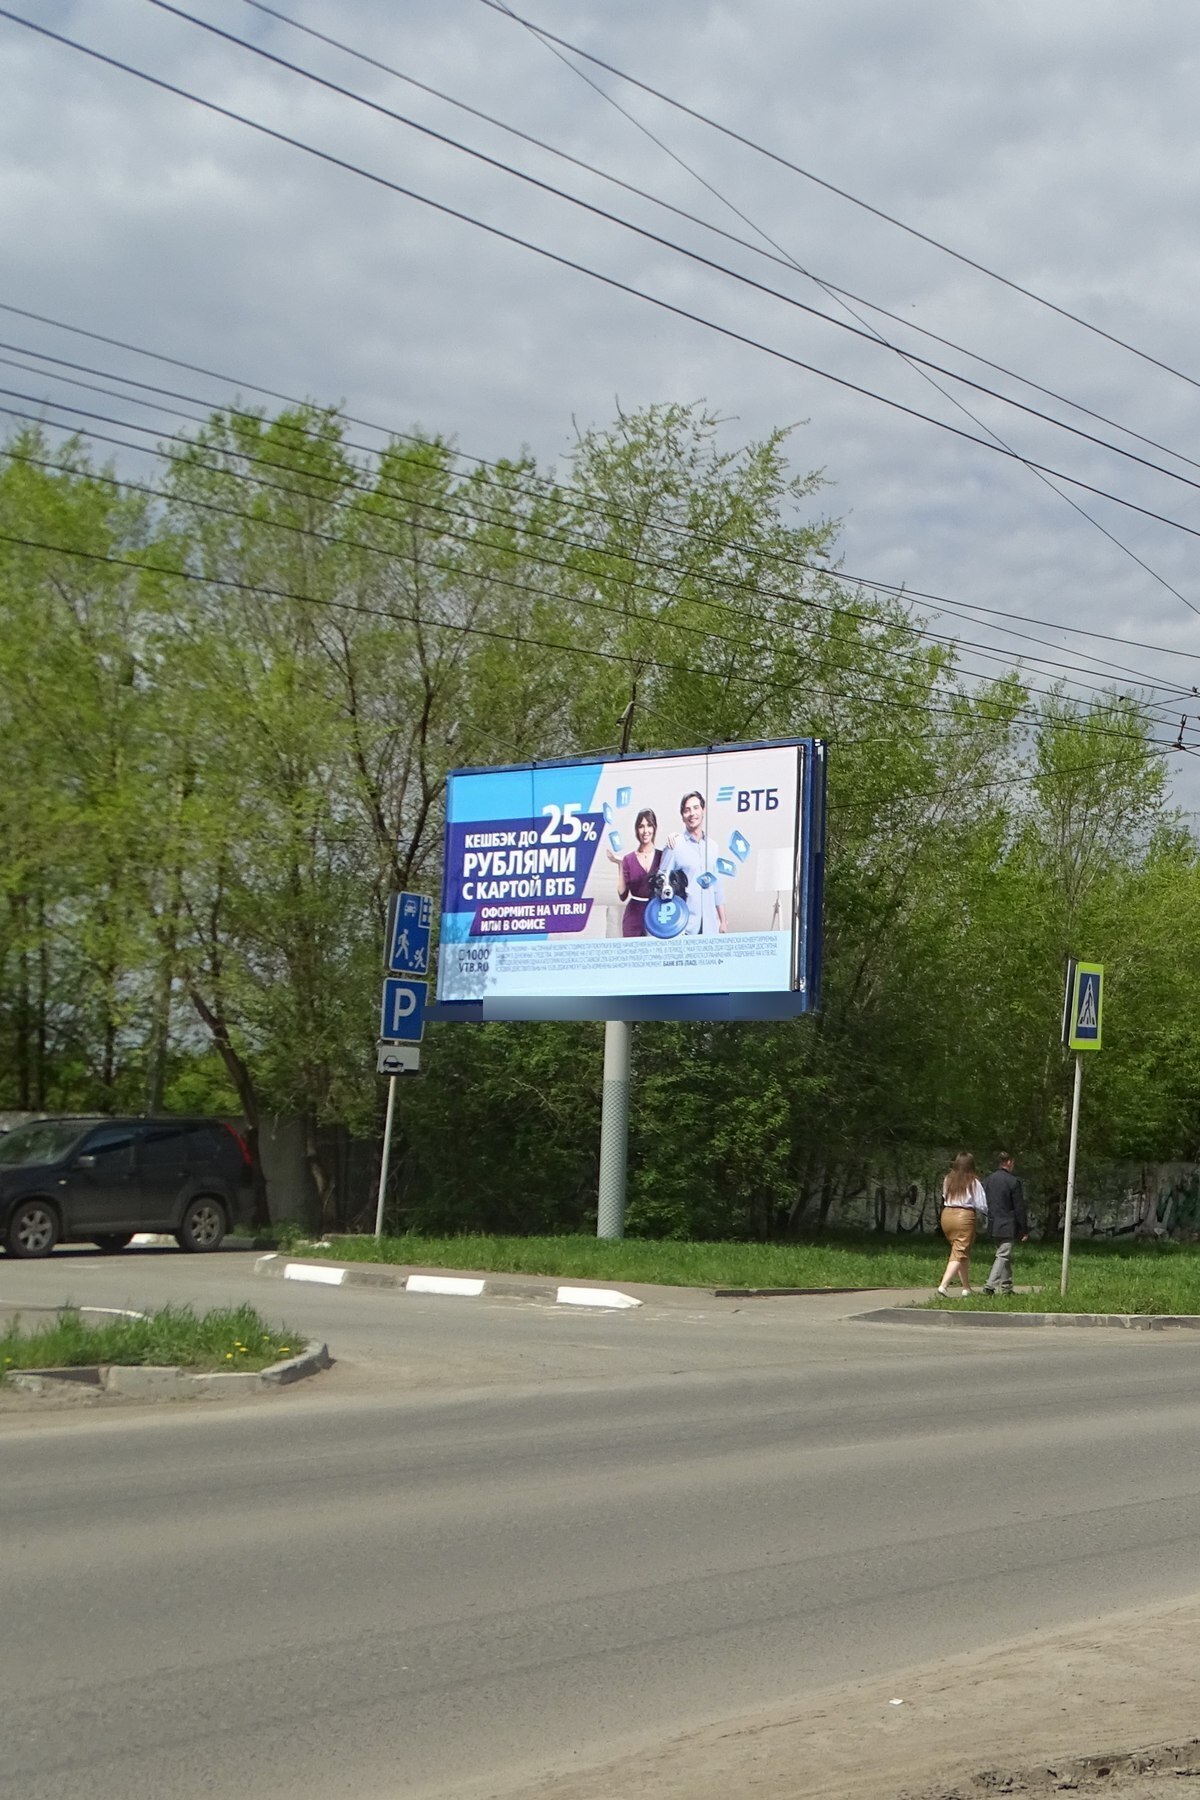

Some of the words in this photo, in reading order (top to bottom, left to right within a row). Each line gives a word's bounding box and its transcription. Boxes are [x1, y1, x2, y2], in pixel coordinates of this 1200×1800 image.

[736, 788, 779, 813] ВТБ
[465, 832, 517, 849] КЕШБЭК
[518, 830, 538, 848] ДО
[540, 803, 598, 845] 25%
[463, 847, 577, 878] РУБЛЯМИ
[462, 882, 474, 901] С
[476, 875, 541, 900] КАРТОЙ
[545, 877, 576, 897] ВТБ
[481, 905, 535, 919] ОФОРМИТЕ
[536, 904, 551, 917] НА
[552, 902, 587, 916] VTB.RU
[480, 919, 502, 932] ИЛИ
[503, 918, 511, 931] В
[511, 918, 546, 931] ОФИСЕ
[458, 961, 489, 973] VTB.RU
[466, 949, 490, 961] 1000
[392, 988, 417, 1032] P
